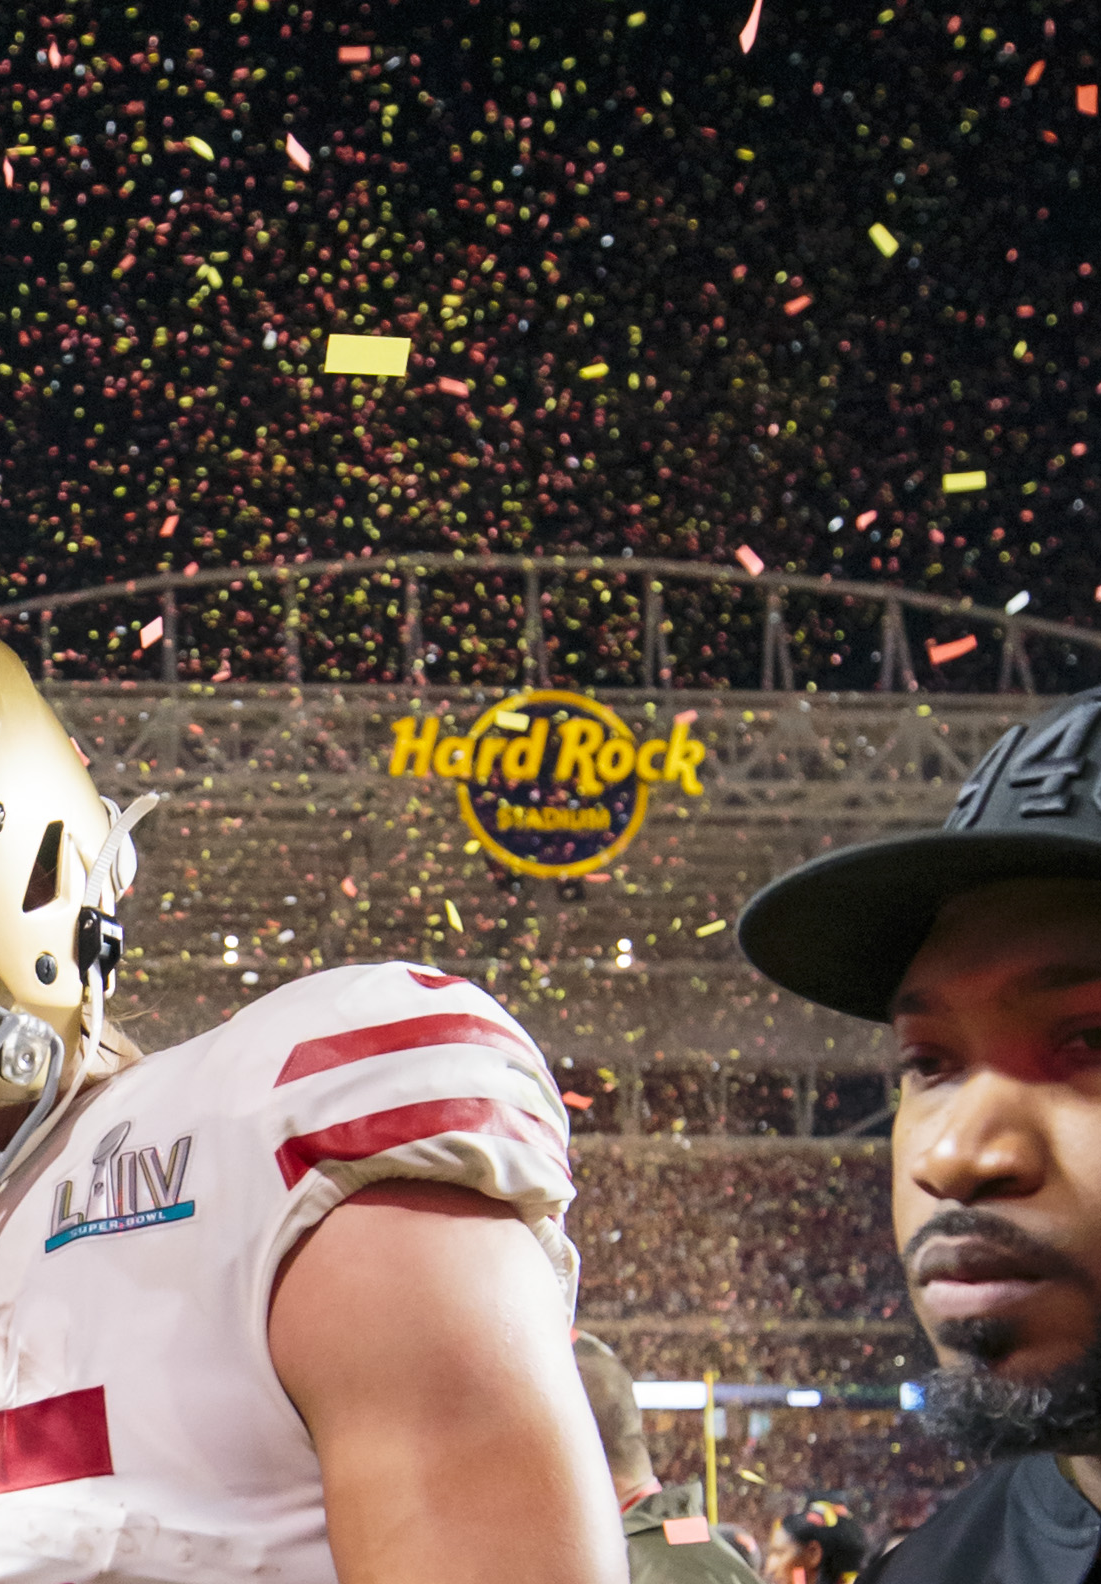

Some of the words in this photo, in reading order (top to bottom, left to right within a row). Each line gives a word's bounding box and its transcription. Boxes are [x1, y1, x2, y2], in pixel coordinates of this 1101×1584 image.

[388, 715, 549, 782] Hard
[554, 714, 706, 796] Rock
[498, 806, 612, 832] STADIUM
[50, 1135, 193, 1236] LIV
[70, 1219, 119, 1237] SUPER
[126, 1211, 167, 1227] BOWL
